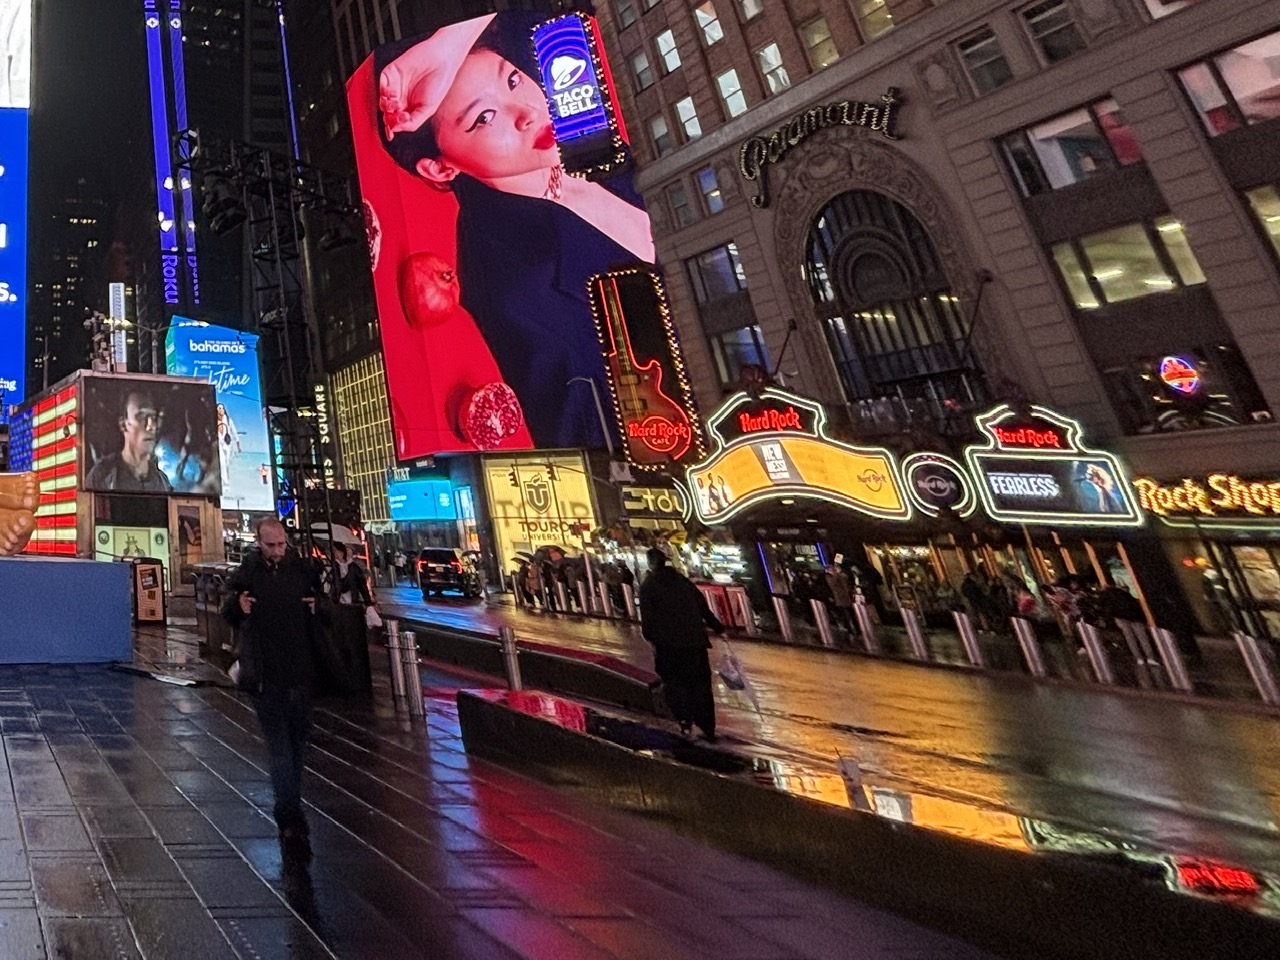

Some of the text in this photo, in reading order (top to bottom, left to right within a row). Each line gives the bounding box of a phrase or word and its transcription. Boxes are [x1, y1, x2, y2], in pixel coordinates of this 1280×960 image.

[552, 84, 594, 106] TACO
[558, 98, 598, 118] BELL
[739, 86, 907, 209] Paramount
[162, 254, 179, 304] ROKU
[189, 339, 246, 354] bahamas
[314, 384, 330, 444] SQUARE
[739, 406, 803, 433] Hard Rock
[628, 422, 688, 438] Hard Rock
[992, 427, 1061, 448] Hard Rock
[392, 467, 410, 481] AT&T
[989, 476, 1058, 497] FEARLESS
[1132, 478, 1216, 516] Rock
[517, 521, 571, 533] TOURO
